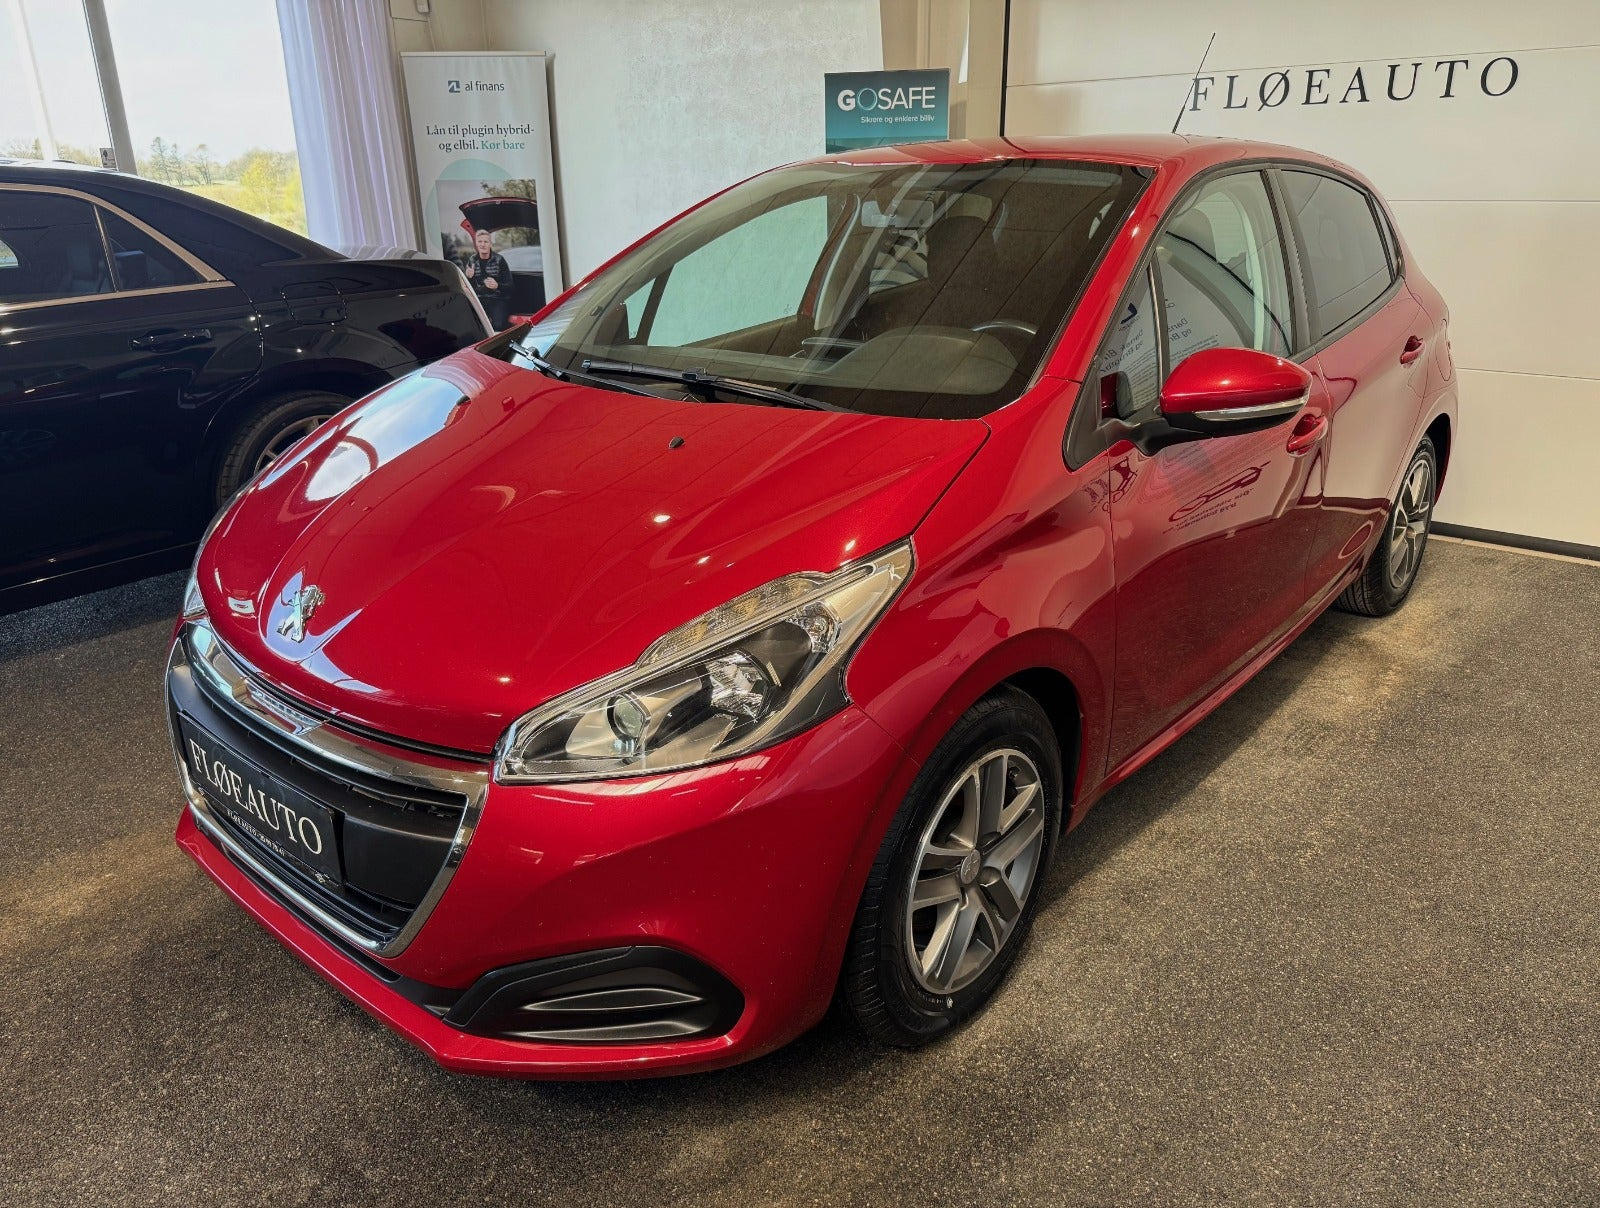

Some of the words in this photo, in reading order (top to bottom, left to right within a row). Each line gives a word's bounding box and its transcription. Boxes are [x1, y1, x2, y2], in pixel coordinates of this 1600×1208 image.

[465, 81, 473, 91] al
[475, 80, 505, 91] finans
[1189, 57, 1519, 111] FLØEAUTO
[837, 86, 936, 111] GOSAFE
[426, 124, 446, 135] Lån
[448, 125, 459, 135] til
[461, 124, 494, 137] plugin
[496, 124, 535, 137] hybrid-
[438, 143, 452, 153] og
[453, 140, 479, 150] elbil.
[481, 140, 500, 150] Kør
[503, 139, 525, 150] bare
[189, 738, 322, 855] FLØEAUTO
